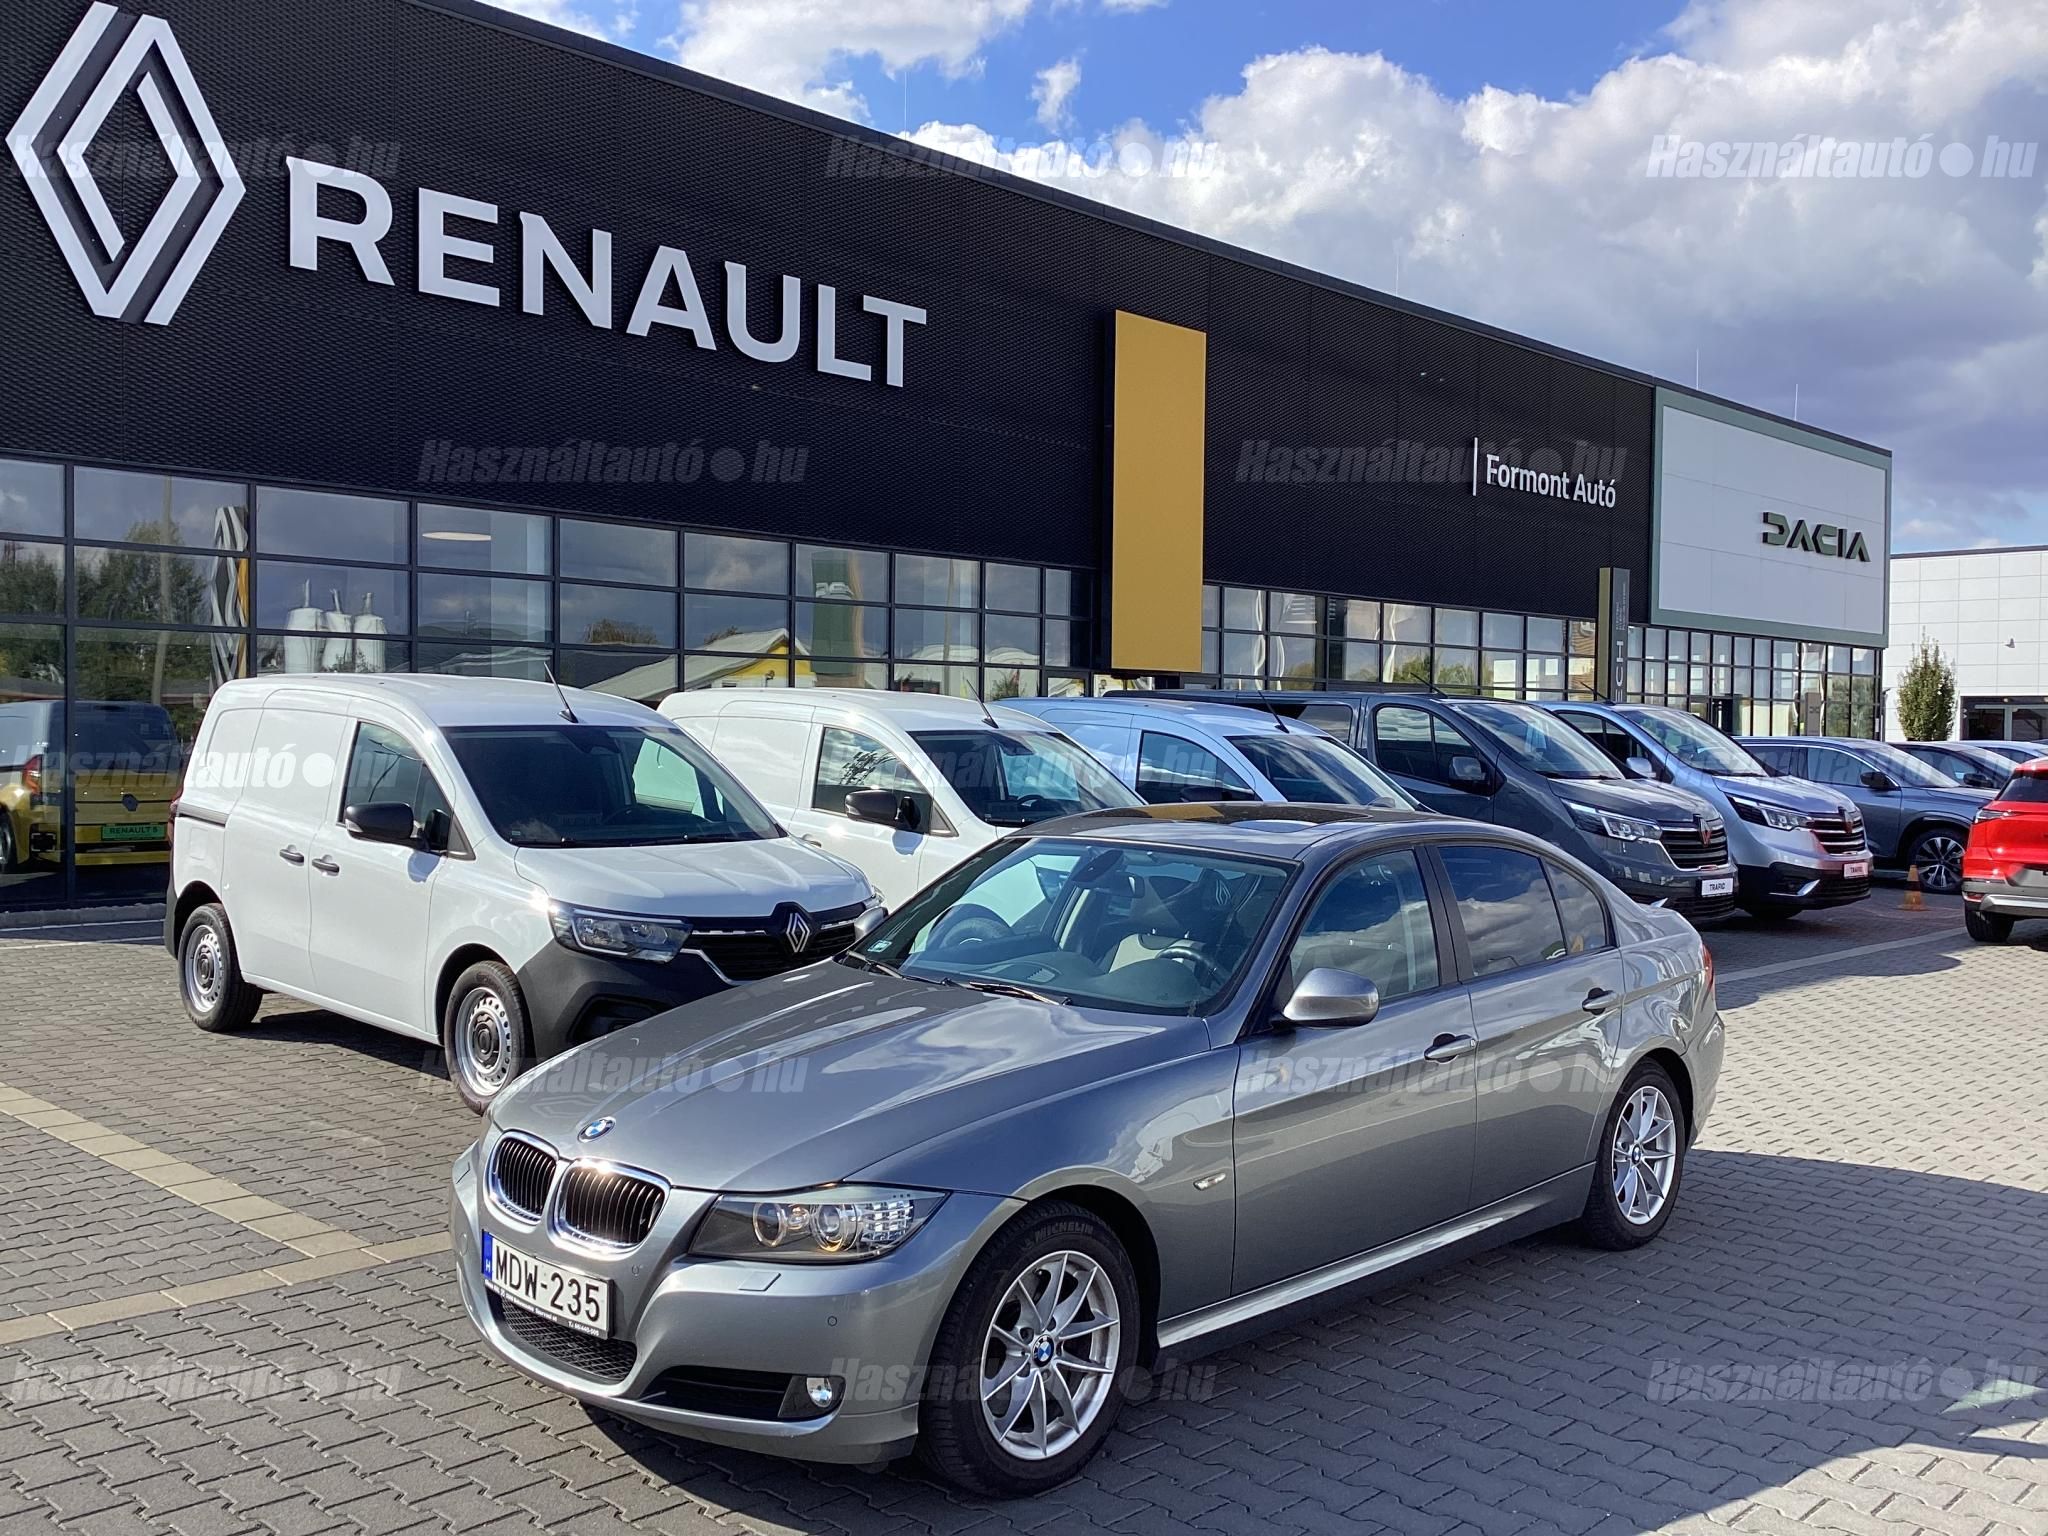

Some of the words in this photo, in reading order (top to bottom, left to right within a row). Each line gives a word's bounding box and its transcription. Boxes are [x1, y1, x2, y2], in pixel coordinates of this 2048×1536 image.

[286, 155, 927, 389] RENAULT
[1486, 453, 1570, 499] Formont
[1573, 473, 1616, 508] Autó
[1762, 511, 1871, 562] DACIA
[1034, 1222, 1094, 1242] MICHELIN
[495, 1246, 599, 1322] MDW-235
